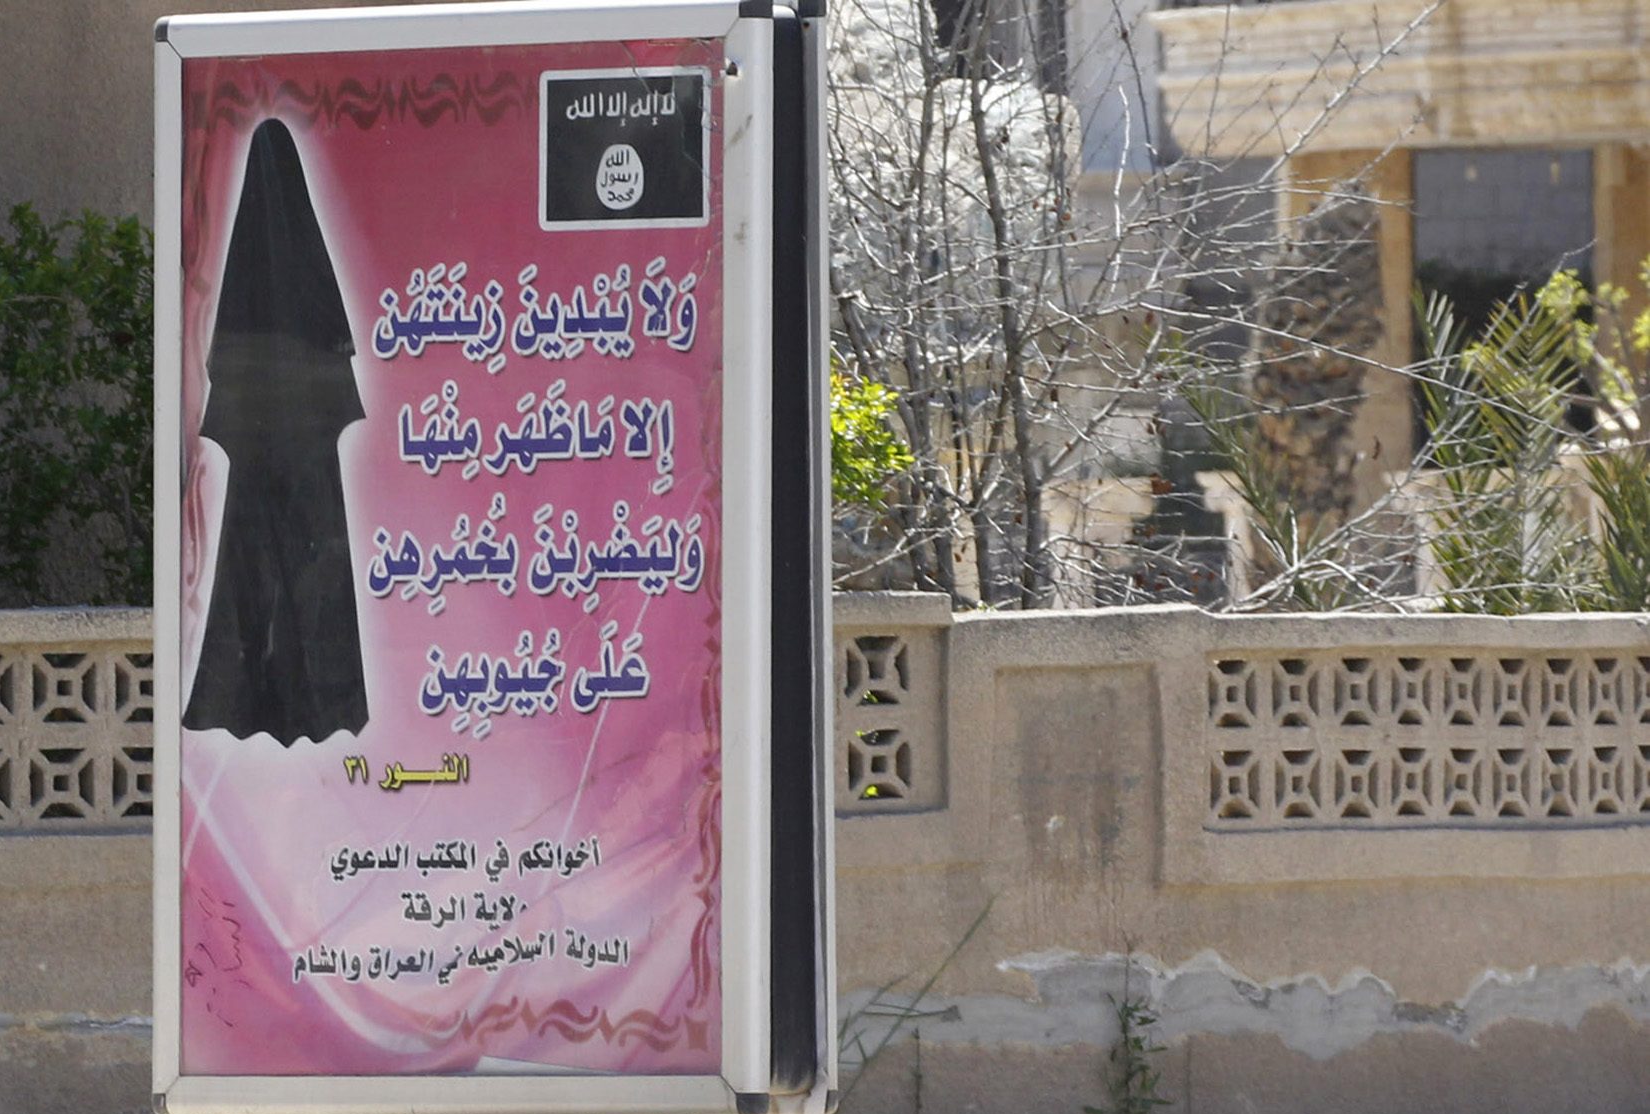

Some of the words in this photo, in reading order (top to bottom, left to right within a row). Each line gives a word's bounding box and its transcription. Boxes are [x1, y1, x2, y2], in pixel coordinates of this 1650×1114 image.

[566, 91, 604, 120] الله
[331, 843, 409, 881] الدعوي
[416, 841, 476, 877] المكتب
[486, 840, 510, 882] في
[518, 839, 600, 877] أخوانكم
[401, 892, 465, 929] الرقة
[473, 892, 528, 931] لاية
[294, 945, 362, 981] والشام
[368, 946, 434, 980] العراق
[565, 929, 629, 967] الدولة
